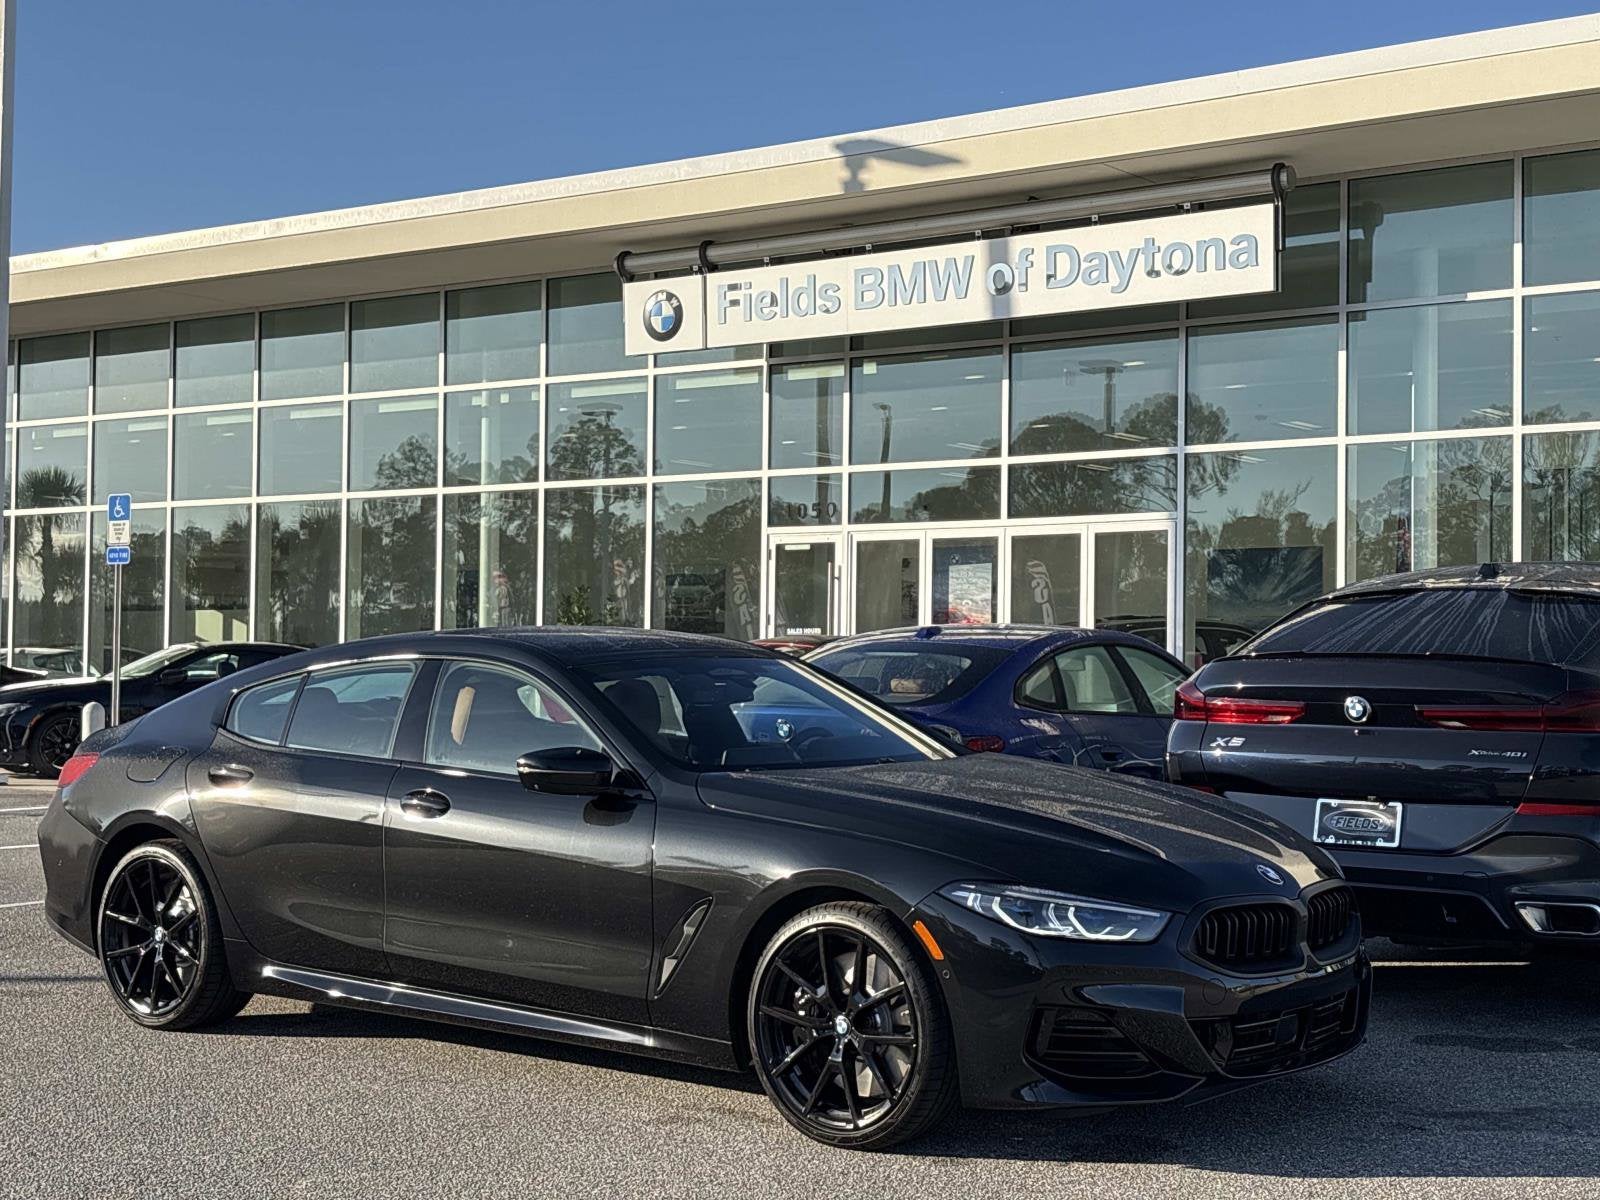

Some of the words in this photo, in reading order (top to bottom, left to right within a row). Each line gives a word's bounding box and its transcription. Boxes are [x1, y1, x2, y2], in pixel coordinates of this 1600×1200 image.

[717, 273, 841, 326] Fields
[853, 256, 975, 310] BMW
[986, 247, 1034, 297] of
[1045, 232, 1259, 294] Daytona
[1334, 815, 1381, 830] FIELDS
